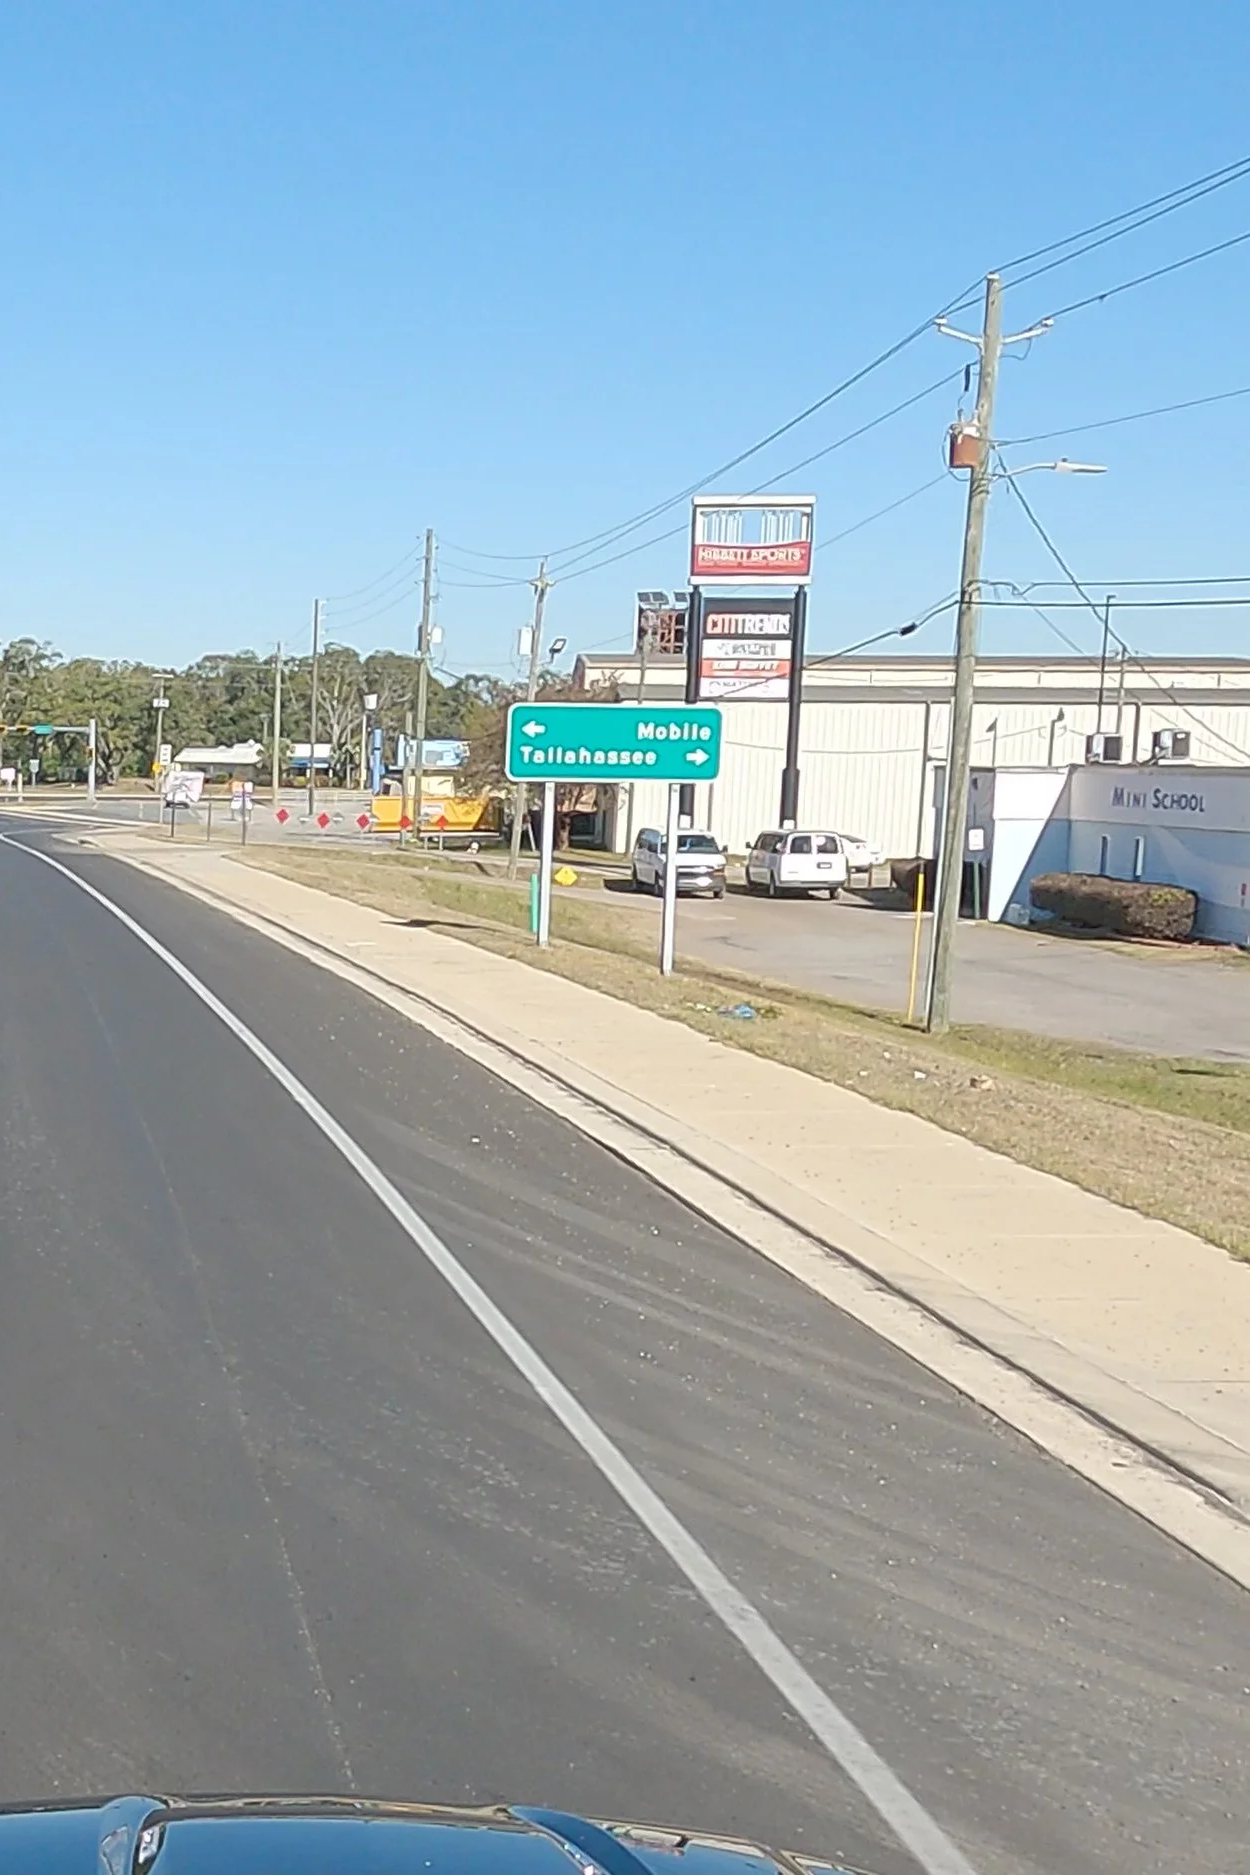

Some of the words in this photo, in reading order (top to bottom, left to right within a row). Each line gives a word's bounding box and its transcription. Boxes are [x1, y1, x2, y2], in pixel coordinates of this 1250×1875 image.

[637, 722, 711, 740] Mobile
[520, 746, 657, 765] Tallahassee
[1112, 786, 1147, 808] MINI
[1152, 788, 1205, 812] SCHOOL
